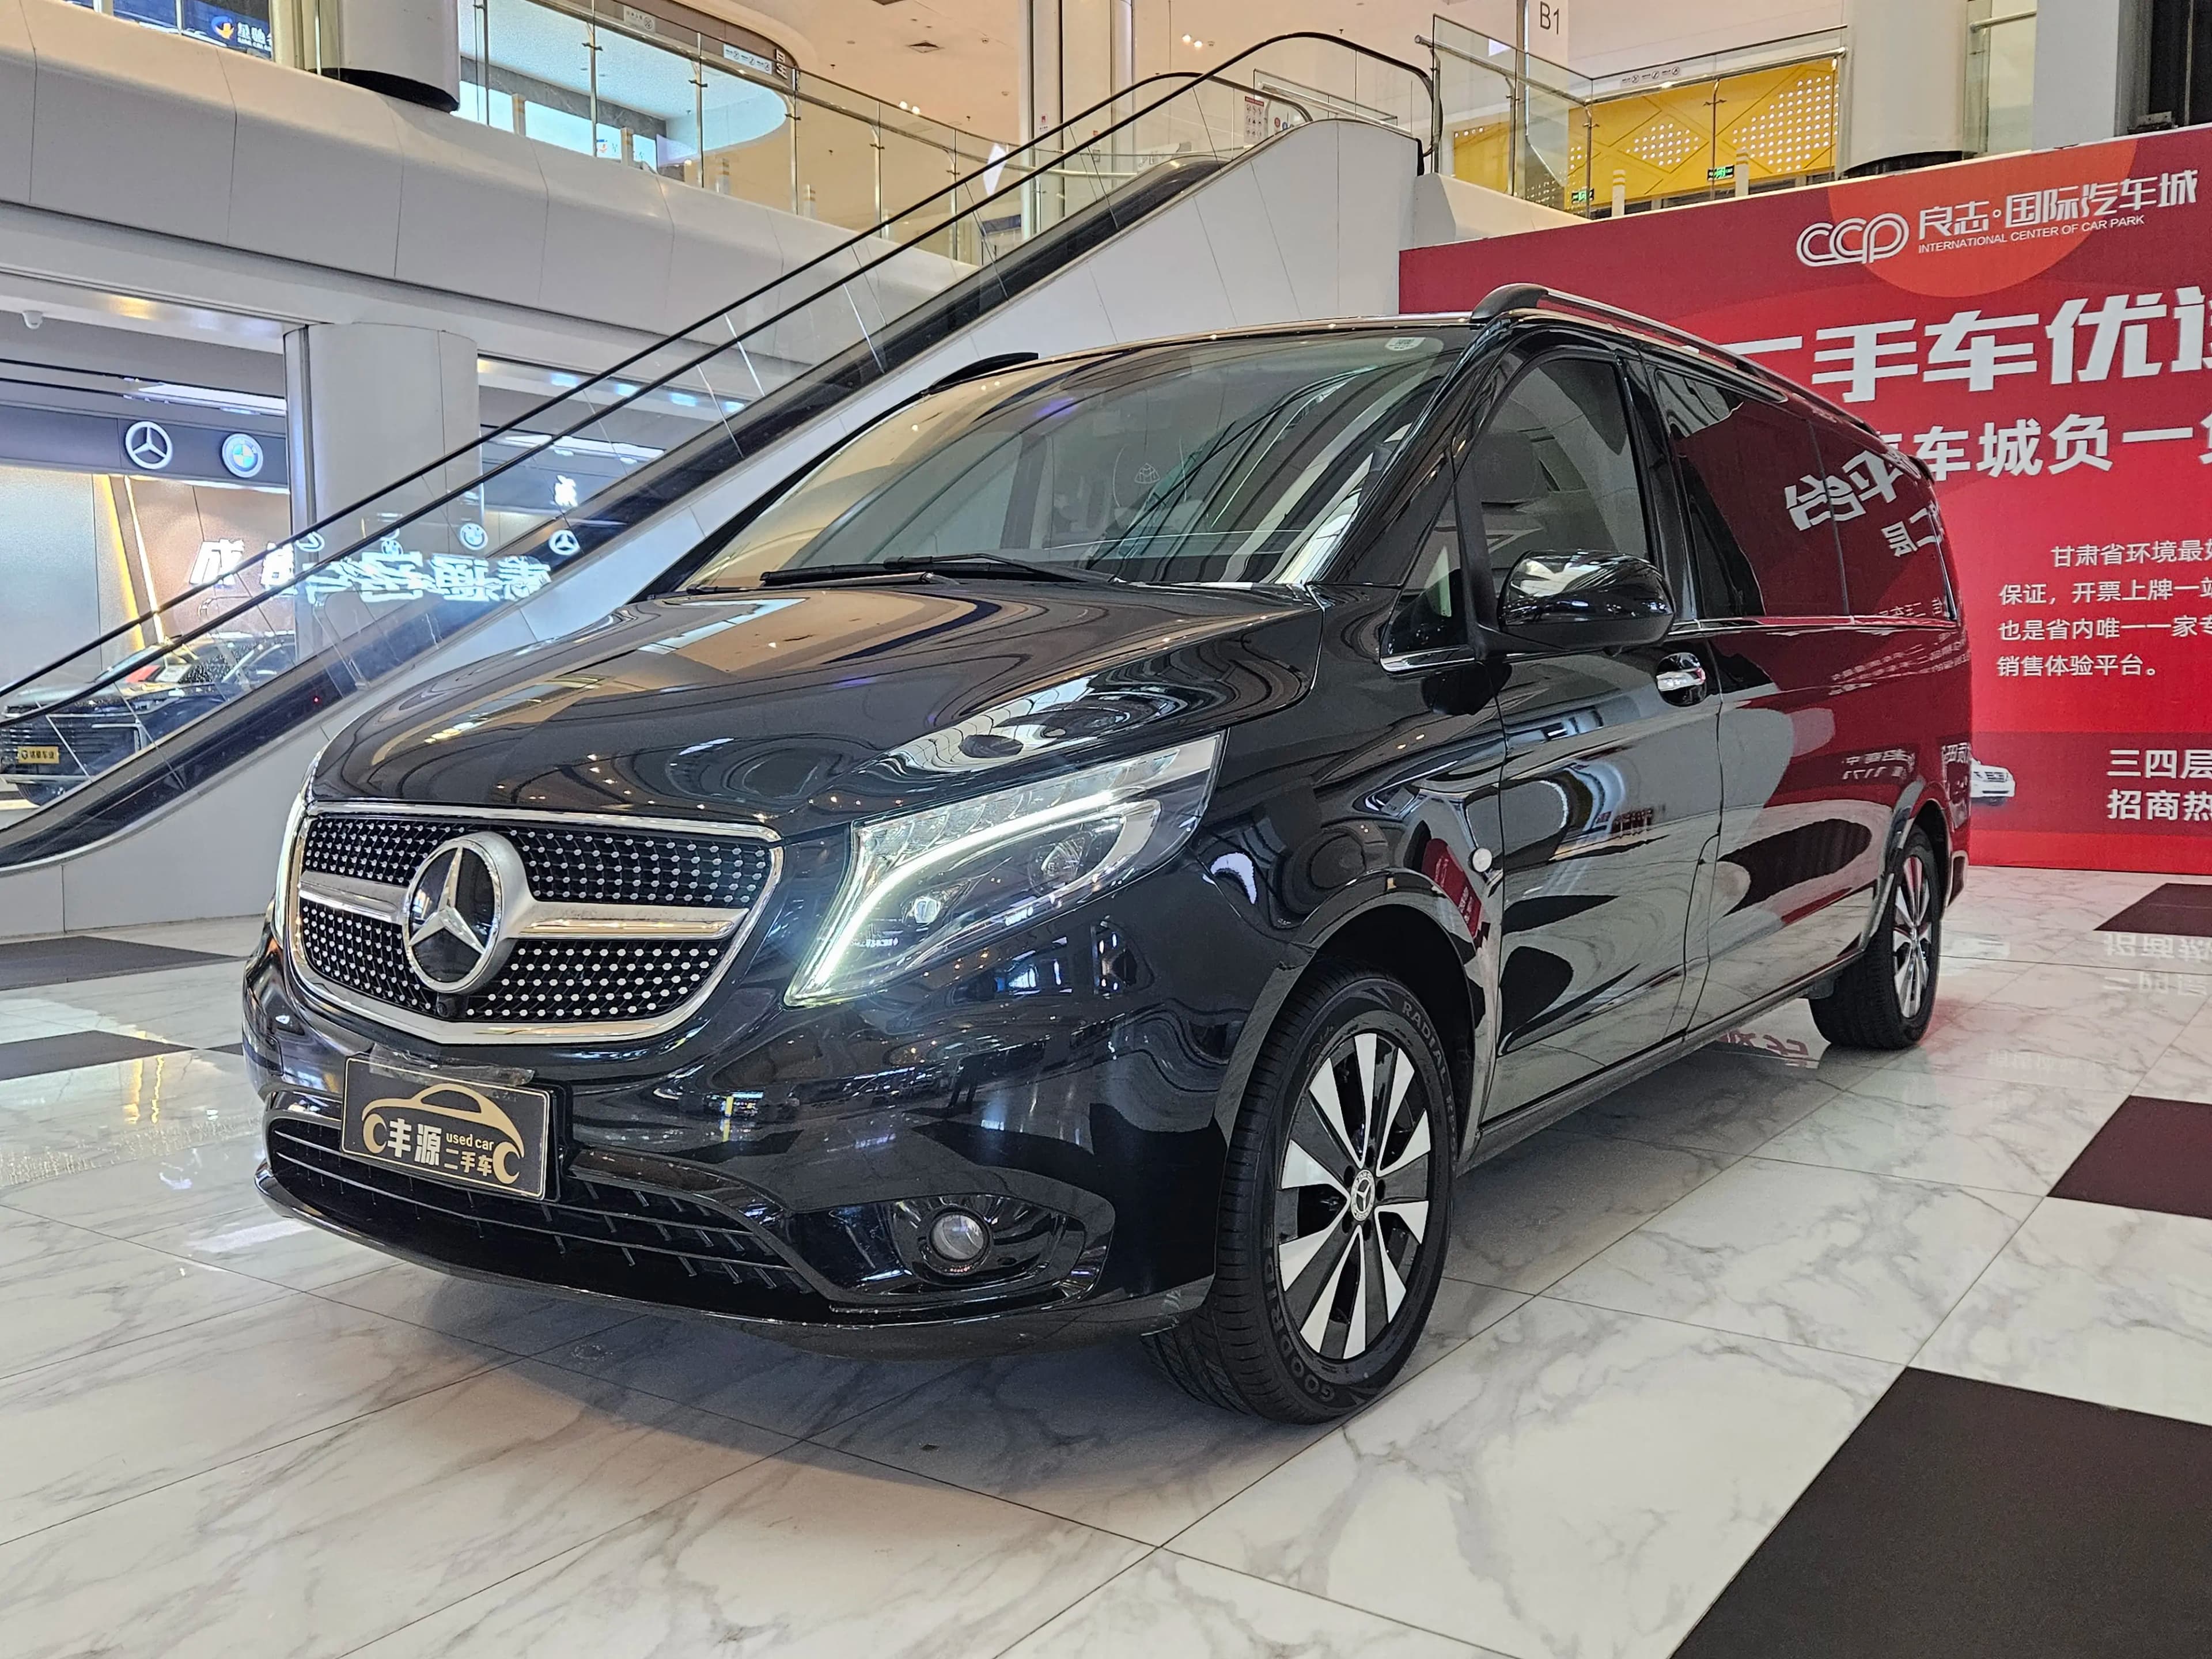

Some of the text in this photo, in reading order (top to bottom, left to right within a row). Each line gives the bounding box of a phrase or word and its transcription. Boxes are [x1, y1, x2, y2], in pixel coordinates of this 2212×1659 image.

[1540, 1, 1559, 35] B1
[1918, 214, 2145, 254] INTERNATIONAL CENTER OF CAR PARK
[1877, 413, 2212, 482] 车城负一
[1995, 653, 2157, 677] 销售体验平台。
[2106, 749, 2212, 780] 三四层
[2106, 788, 2212, 822] 招商热
[1402, 1000, 1446, 1084] RADIAL
[387, 1118, 442, 1166] 丰源
[445, 1132, 495, 1151] used car
[444, 1147, 494, 1177] 二手车
